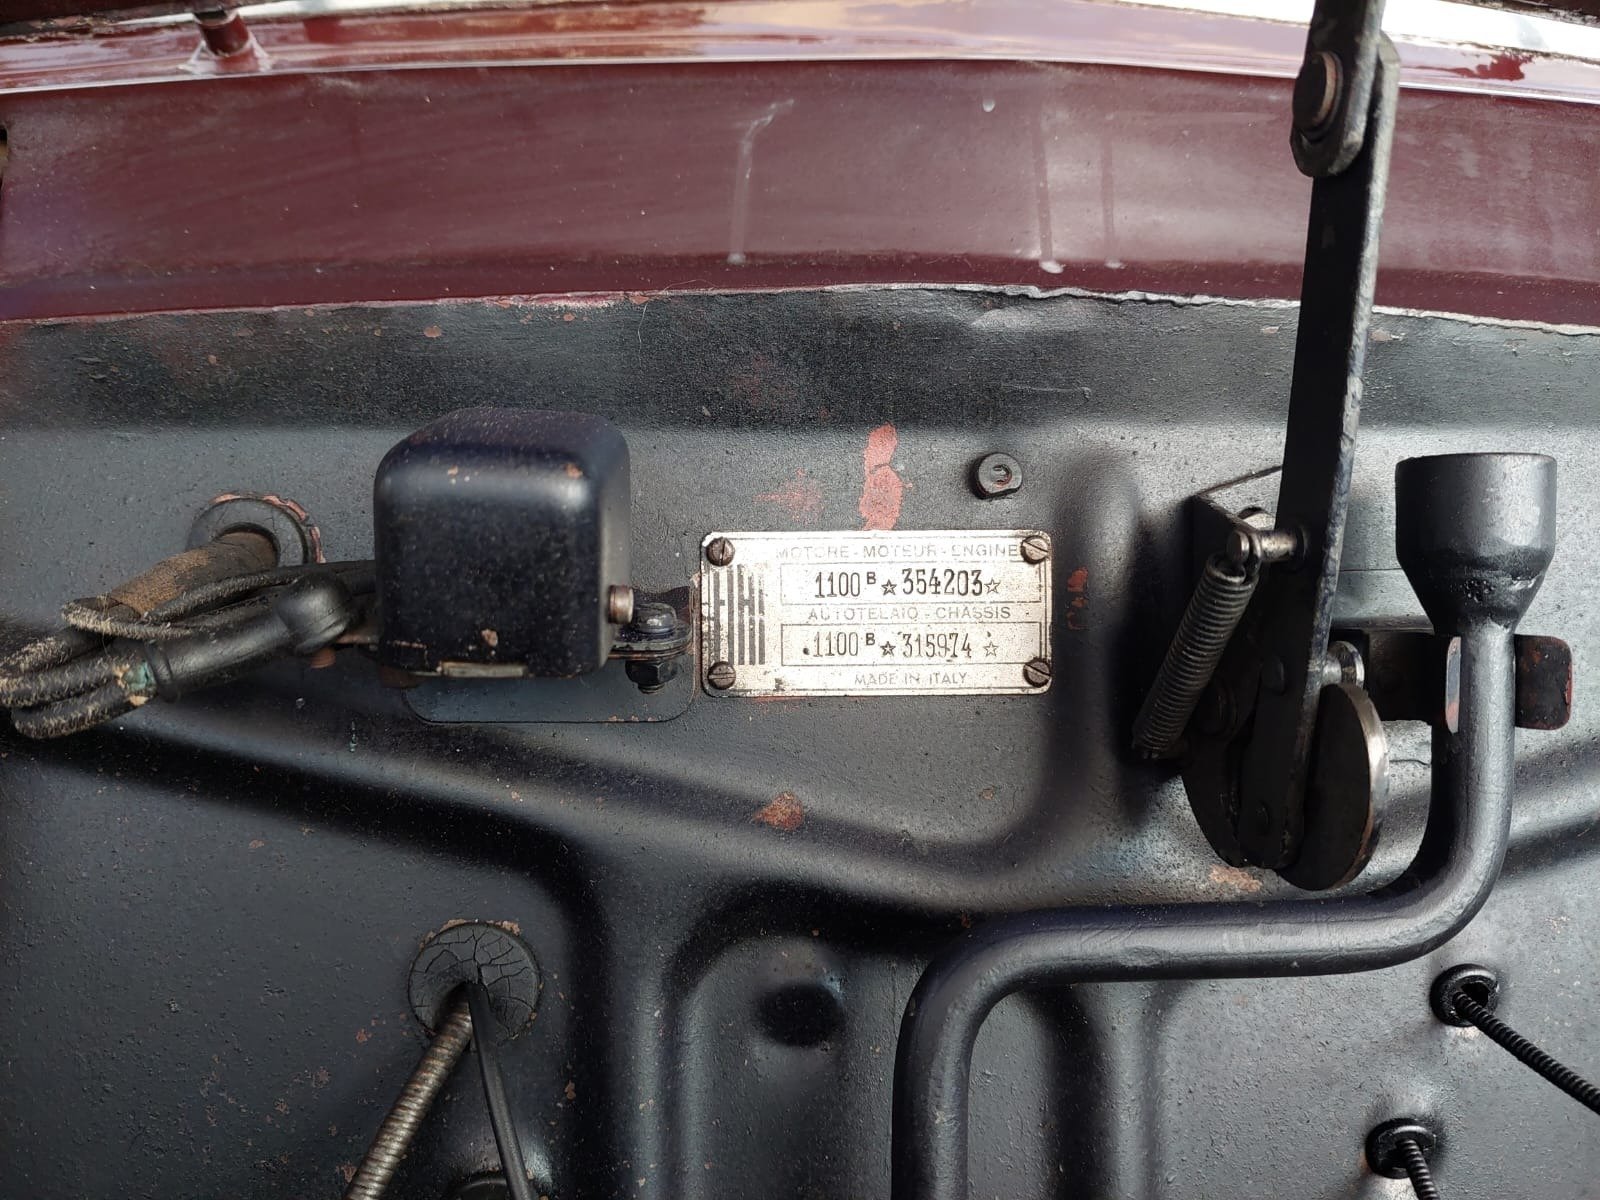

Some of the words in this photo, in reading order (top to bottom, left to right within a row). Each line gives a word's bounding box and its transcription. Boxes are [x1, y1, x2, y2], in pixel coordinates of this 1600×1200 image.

[776, 546, 849, 559] MOTORE
[863, 545, 937, 558] MOTEUR
[952, 544, 1018, 557] ENGINE
[814, 571, 861, 598] 1100
[901, 568, 983, 597] 354203
[807, 607, 919, 621] AUTOTELAIO
[935, 606, 1012, 619] CHASSIS
[813, 631, 859, 657] 1100
[902, 632, 972, 658] 315974
[854, 674, 897, 685] MADE
[904, 673, 920, 684] IN
[929, 671, 968, 685] ITALY
